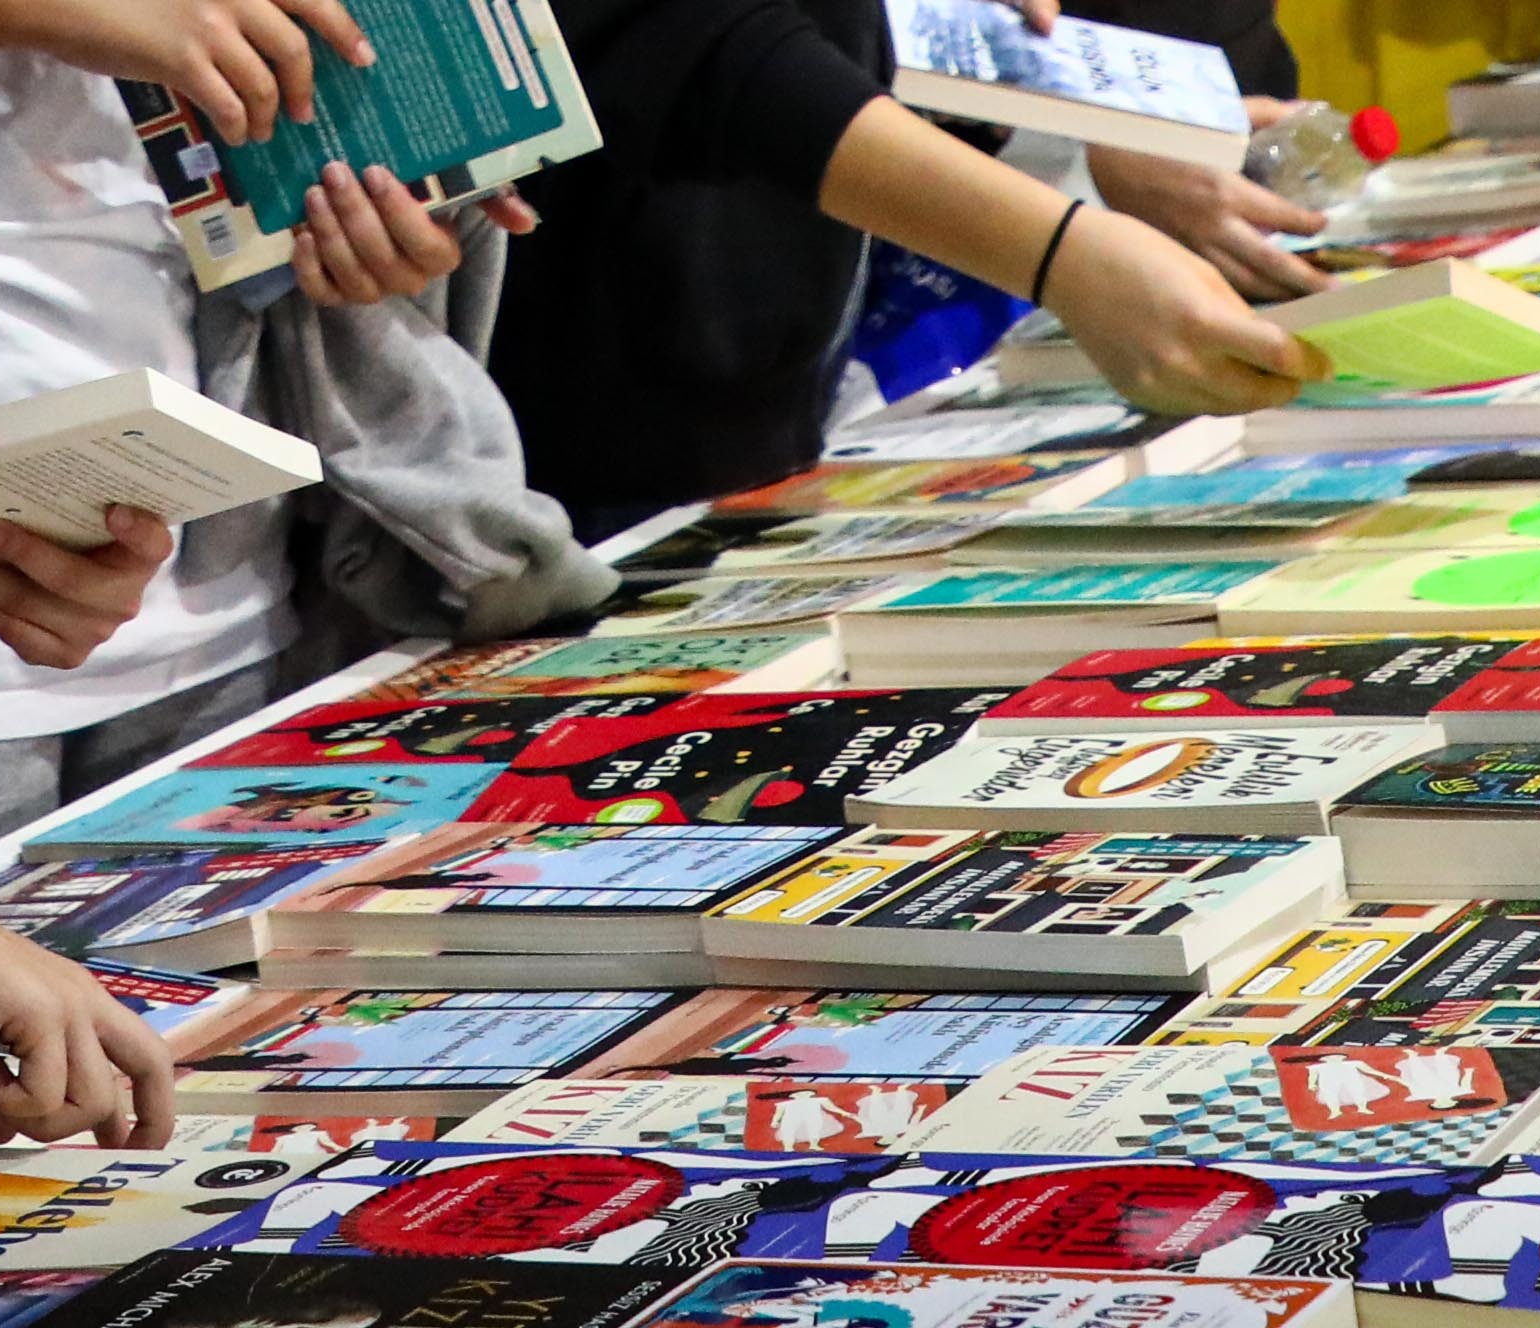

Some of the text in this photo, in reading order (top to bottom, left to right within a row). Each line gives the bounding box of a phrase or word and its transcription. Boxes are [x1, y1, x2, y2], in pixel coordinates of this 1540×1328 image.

[588, 760, 642, 791] Pin
[633, 731, 713, 791] Cecile
[813, 726, 896, 787] Ruhlar
[859, 722, 944, 791] Gezgin
[961, 737, 1127, 802] Eugenides
[1219, 752, 1337, 798] Evlilik
[999, 1050, 1140, 1102] KIZ
[485, 1085, 630, 1140] KIZ
[106, 1258, 232, 1328] ALEX MICH
